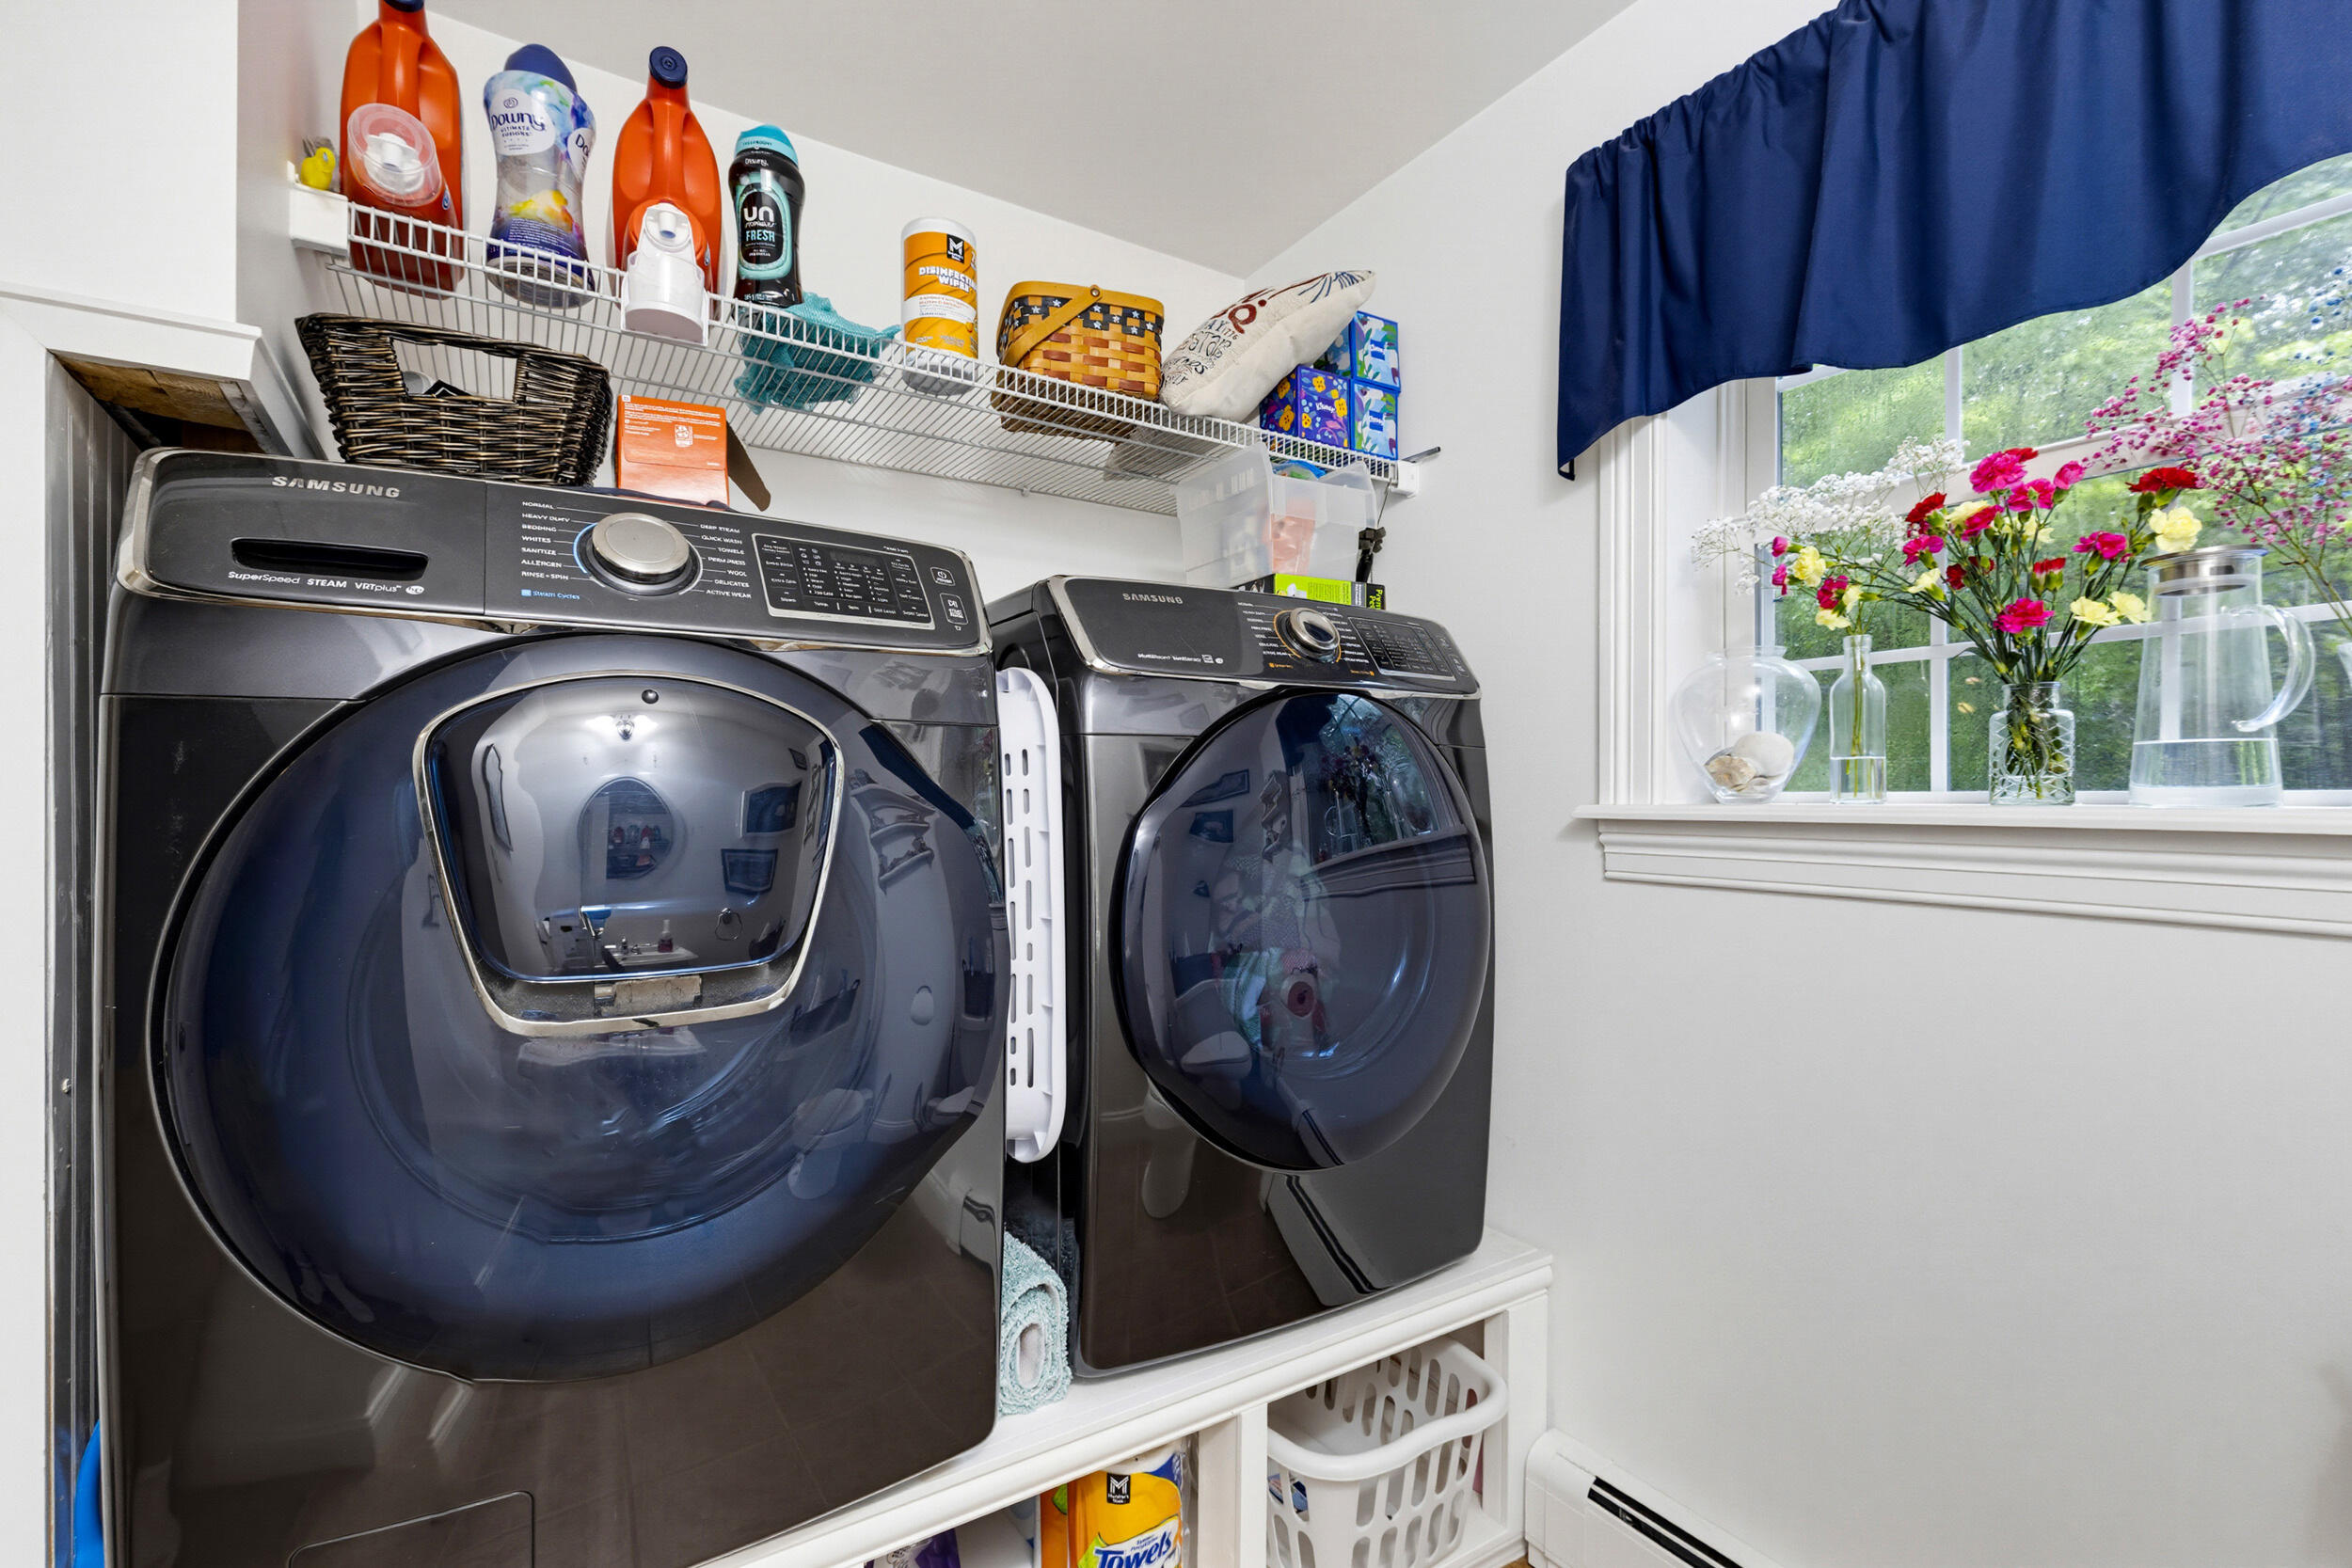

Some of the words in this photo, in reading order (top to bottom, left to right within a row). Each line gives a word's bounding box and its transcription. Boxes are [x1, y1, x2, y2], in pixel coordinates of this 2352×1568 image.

[491, 112, 546, 132] Downy
[746, 230, 776, 243] FRESH
[272, 476, 401, 499] SAMSUNG
[521, 524, 557, 532] BEDDING
[521, 535, 551, 544] WHITES
[521, 546, 557, 556] SANITIZE
[718, 546, 745, 555] TOWELS
[521, 559, 562, 568] ALLERGEN
[228, 571, 301, 585] SuperSpeed
[307, 578, 347, 588] STEAM
[714, 578, 750, 588] DELICATES
[1122, 593, 1184, 605] SAMSUNG
[1094, 1530, 1173, 1568] Towels
